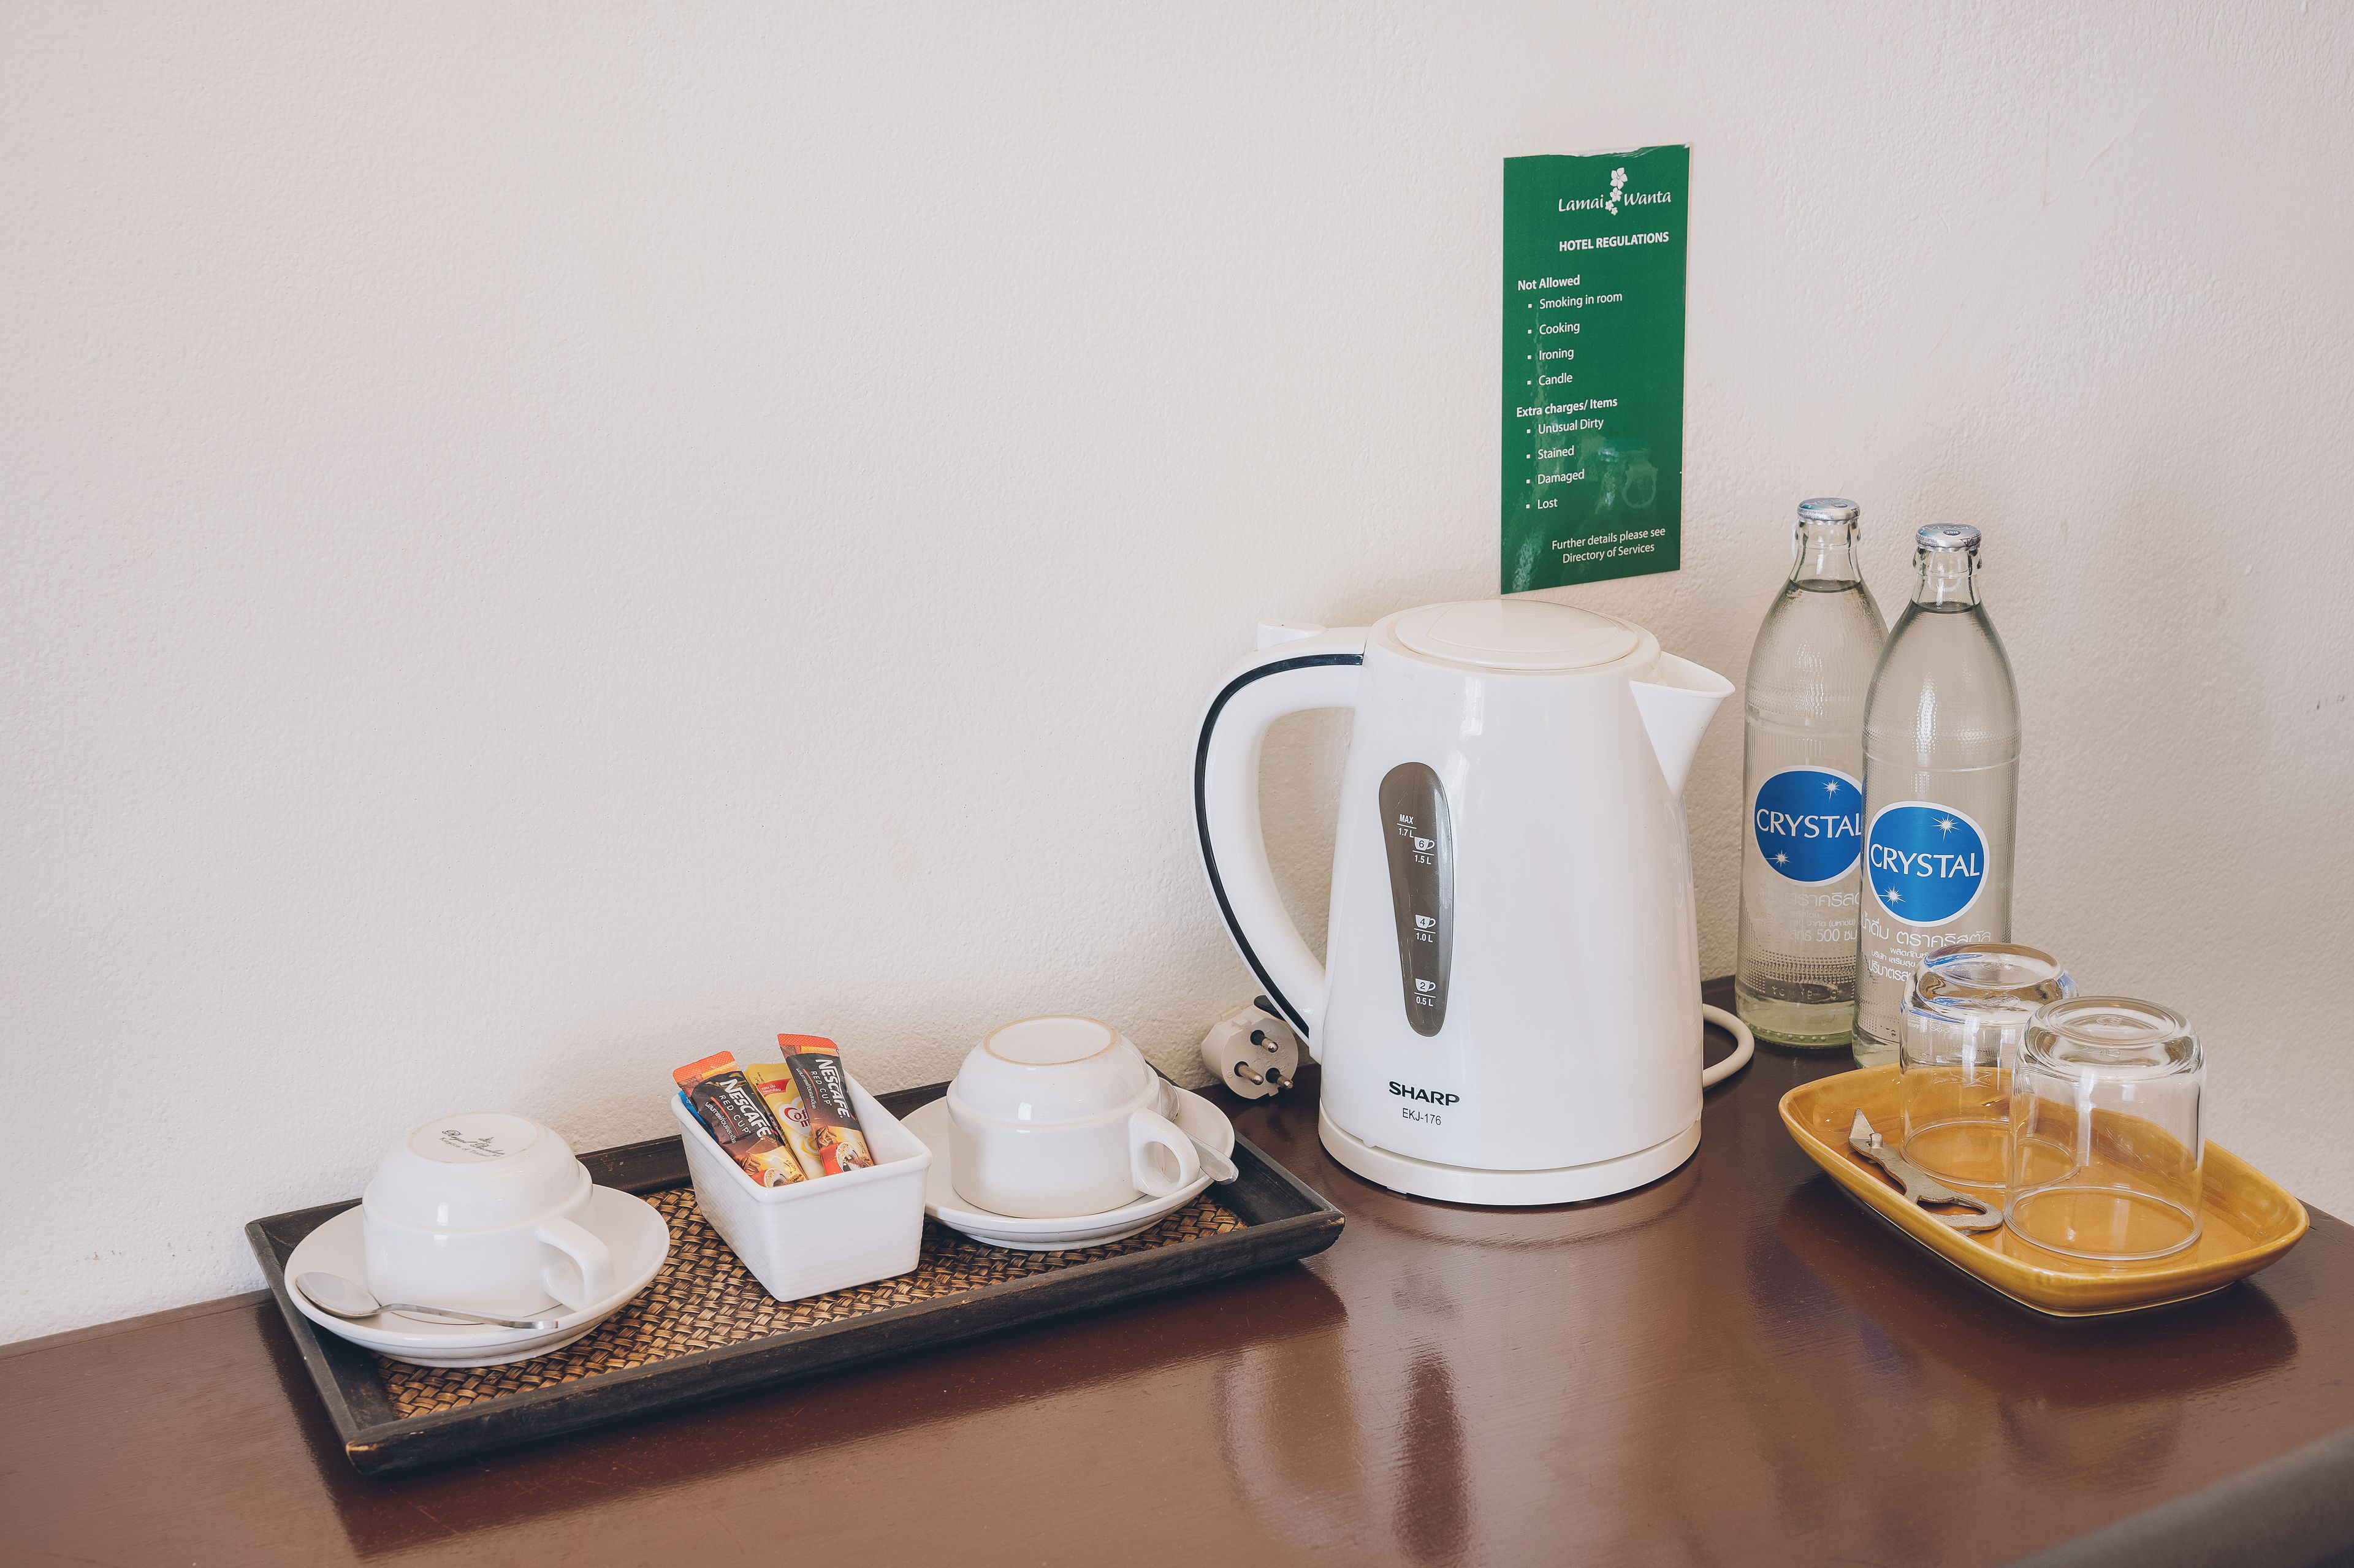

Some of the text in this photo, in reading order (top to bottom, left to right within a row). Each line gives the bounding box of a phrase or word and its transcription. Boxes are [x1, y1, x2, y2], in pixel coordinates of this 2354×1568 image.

[1558, 191, 1672, 211] Lamai Wanta
[1559, 232, 1669, 251] HOTEL REGULATIONS
[1517, 275, 1580, 291] Not Allowed
[1539, 293, 1623, 310] Smoking in room
[1539, 322, 1580, 335] Cooking
[1539, 348, 1574, 361] Ironing
[1538, 373, 1573, 386] Candle
[1517, 405, 1542, 417] Extra
[1590, 398, 1618, 409] Items
[1538, 418, 1604, 435] Unusual Dirty
[1537, 446, 1574, 460] Stained
[1537, 469, 1585, 484] Damaged
[1537, 498, 1558, 509] Lost
[1552, 527, 1666, 550] Further details please see
[1563, 542, 1655, 564] Directory of Services
[1399, 813, 1414, 824] MAX
[1756, 809, 1861, 838] CRYSTAL
[1398, 828, 1414, 838] 1.7 L
[1414, 854, 1431, 865] 1.5 L
[1870, 843, 1980, 878] CRYSTAL
[1415, 932, 1433, 943] 1.0 L
[1816, 928, 1840, 942] 500
[1415, 996, 1427, 1005] 0.5
[810, 1070, 823, 1085] RED
[1388, 1081, 1460, 1106] SHARP
[719, 1095, 734, 1111] RED
[1403, 1107, 1441, 1125] EKJ-176
